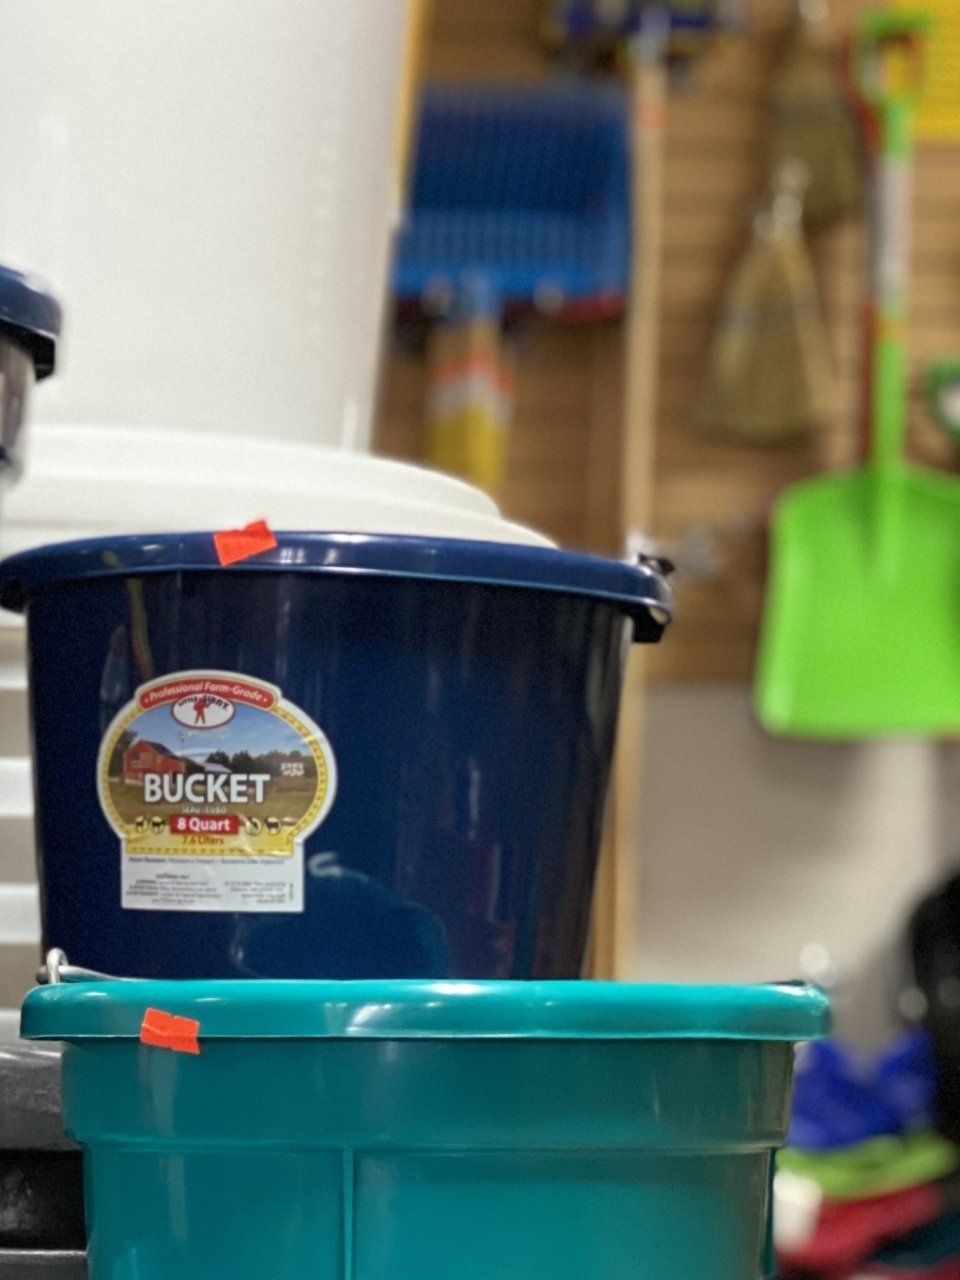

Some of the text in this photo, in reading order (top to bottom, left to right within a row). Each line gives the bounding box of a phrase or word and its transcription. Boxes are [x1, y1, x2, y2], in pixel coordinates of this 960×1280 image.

[149, 682, 263, 702] Professional Farm-Grade
[144, 773, 271, 804] BUCKET
[205, 806, 227, 814] CUBO
[176, 817, 231, 833] 8 Quart
[182, 835, 225, 845] 7.6 Liters
